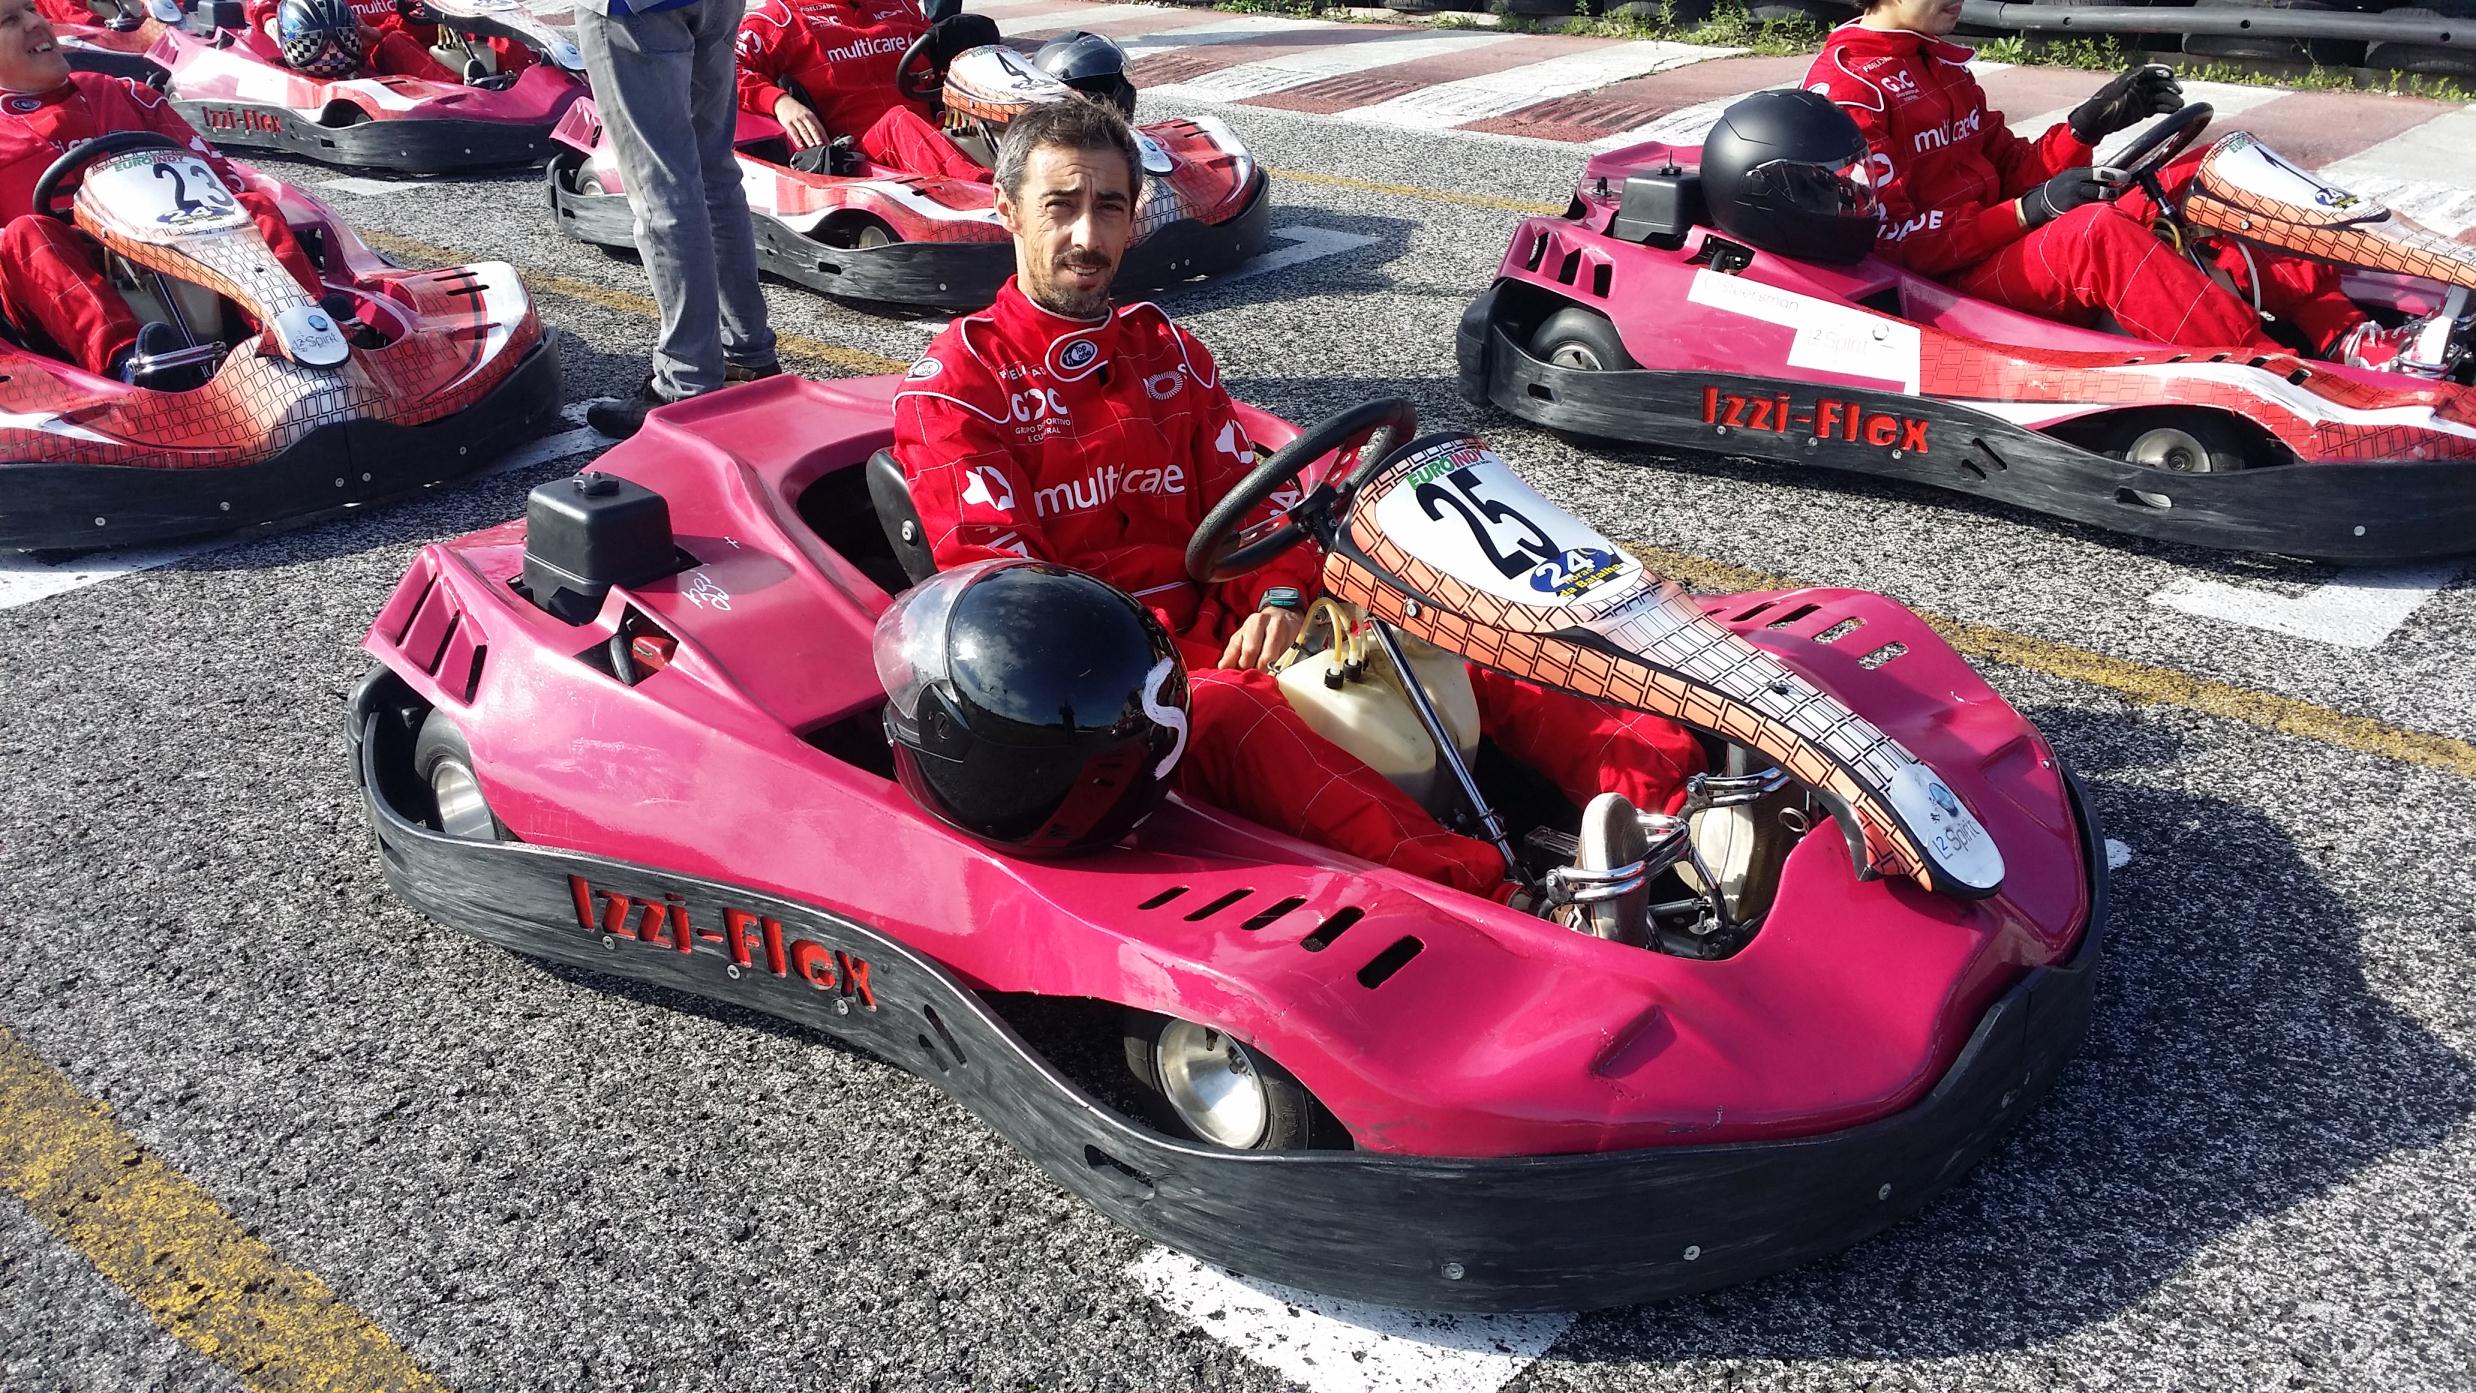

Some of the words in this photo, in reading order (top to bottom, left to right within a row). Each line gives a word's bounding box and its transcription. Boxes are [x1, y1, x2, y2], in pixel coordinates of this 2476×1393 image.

[827, 36, 906, 62] multicare
[115, 154, 185, 173] EUROINDY
[153, 162, 235, 210] 23
[168, 206, 213, 221] 24
[1702, 384, 1928, 454] Izzi-Flex
[1406, 448, 1486, 491] EUROINDY
[1415, 469, 1561, 580] 25
[1535, 550, 1596, 588] 24
[1560, 586, 1578, 597] da
[1575, 563, 1624, 588] Batalha
[567, 873, 878, 1013] Izzi-Flex
